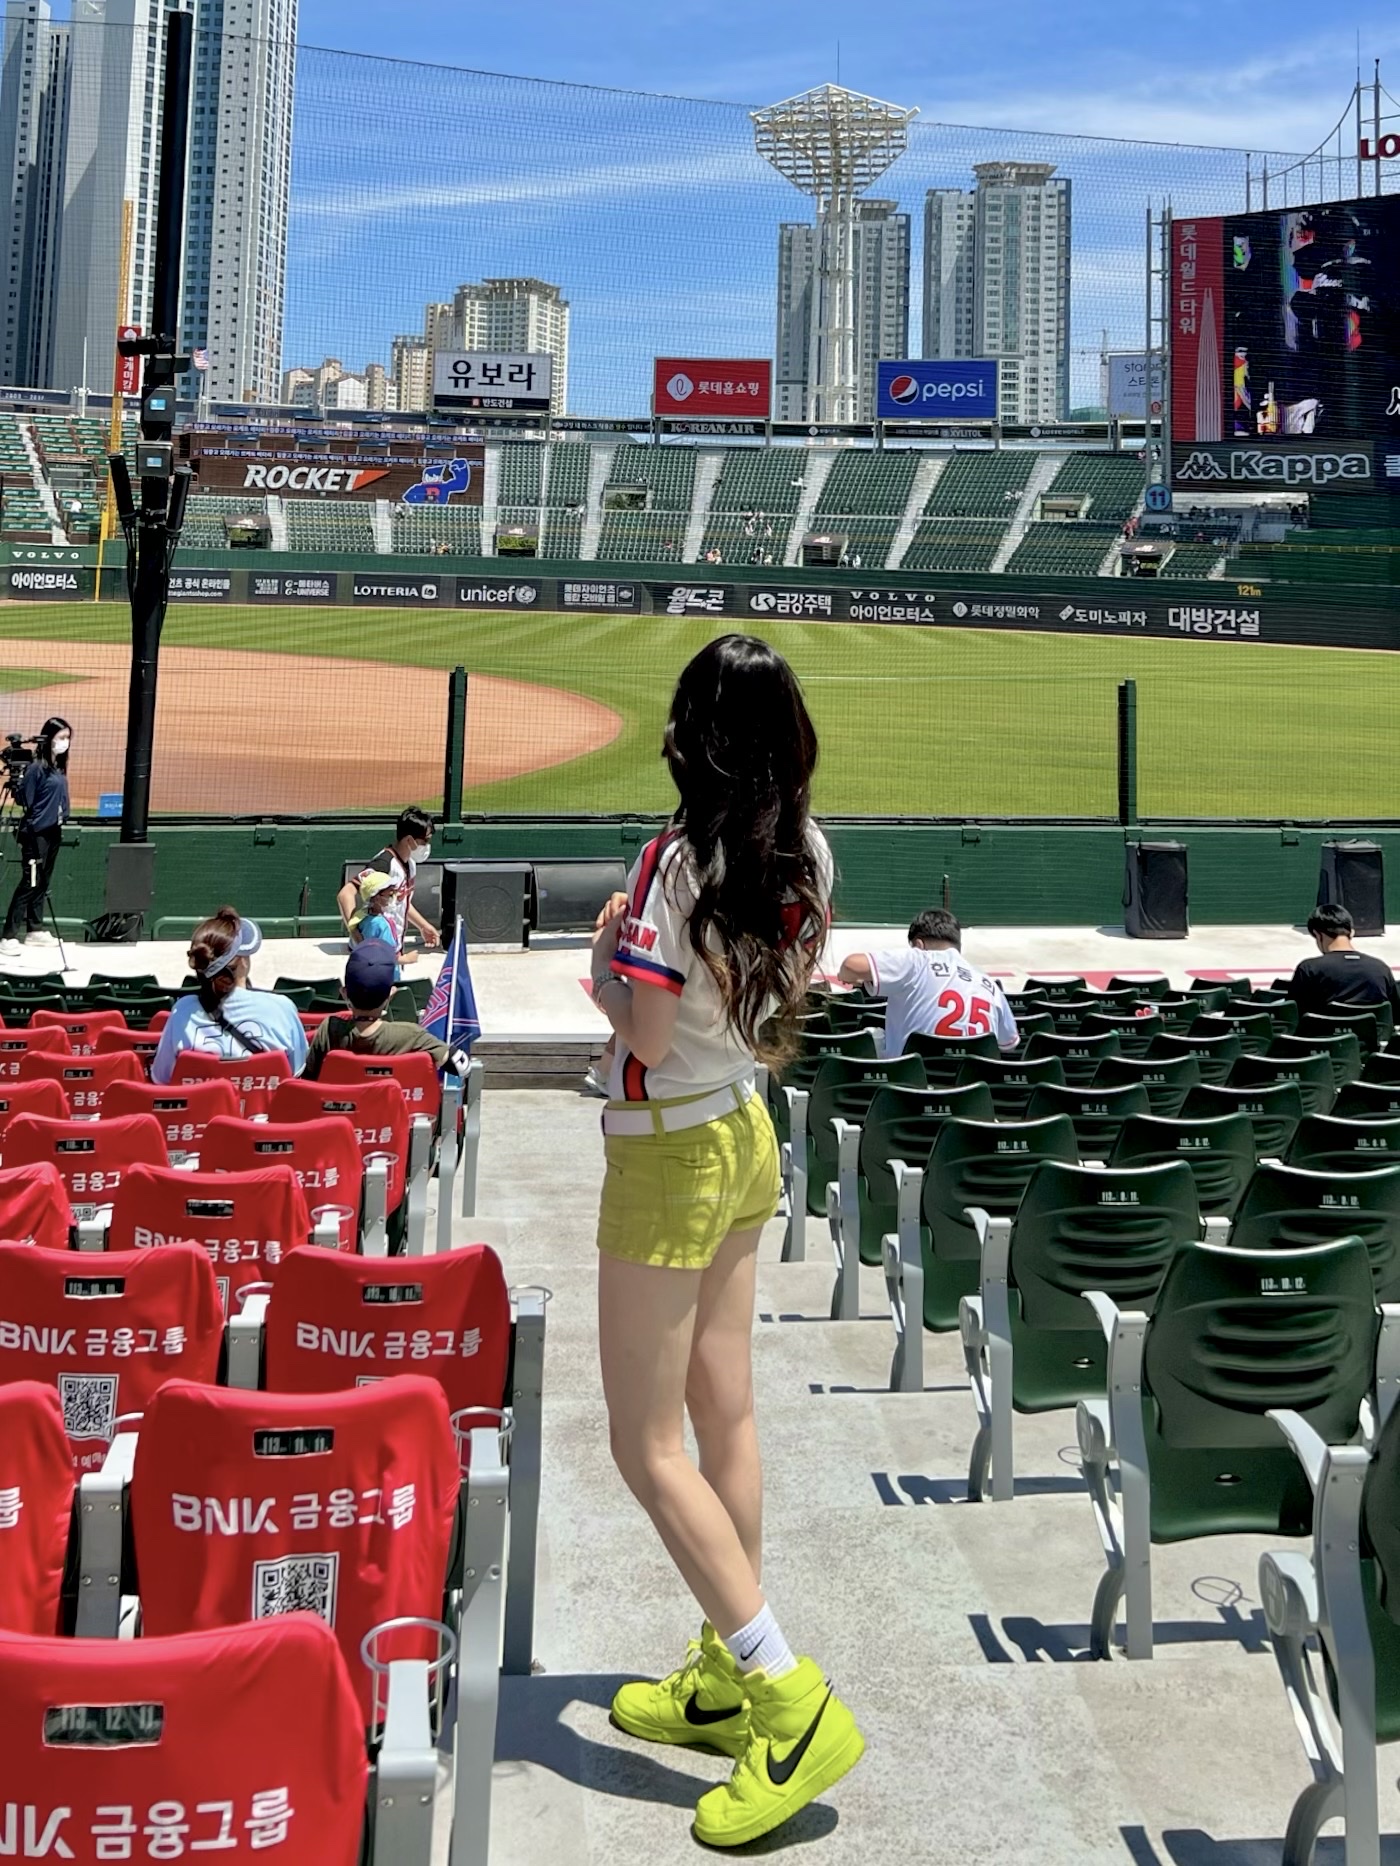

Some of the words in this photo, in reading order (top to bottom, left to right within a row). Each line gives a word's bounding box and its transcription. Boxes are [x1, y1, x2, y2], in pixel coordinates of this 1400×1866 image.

[1179, 224, 1198, 335] 롯데월드타워
[448, 360, 537, 391] 유보라
[698, 380, 759, 396] 롯데홈쇼핑
[923, 379, 984, 401] pepsi
[670, 422, 728, 433] KOREAN
[728, 423, 755, 434] AIR
[950, 429, 983, 438] XYLITOL
[244, 465, 363, 491] ROCKET
[1231, 452, 1370, 484] Kappa
[1149, 491, 1166, 506] 11
[12, 551, 80, 559] VOLVO
[11, 572, 78, 590] 아이언모터스
[354, 585, 419, 597] LOTTERIA
[1237, 585, 1262, 596] 121m
[285, 588, 330, 597] G-UNIVERSE
[460, 586, 515, 602] unicef
[667, 587, 724, 614] 월드콘
[850, 591, 935, 602] VOLVO
[777, 592, 831, 615] 금강주택
[850, 605, 935, 622] 아이언모터스
[971, 604, 1040, 618] 롯데정밀화학
[1074, 609, 1147, 626] 도미노피자
[1168, 607, 1260, 636] 대방건설
[934, 989, 990, 1036] 25
[204, 1239, 283, 1264] 금융그룹
[0, 1320, 78, 1356] BNK
[85, 1326, 187, 1357] 금융그룹
[297, 1322, 376, 1358] BNK
[383, 1327, 483, 1359] 금융그룹
[172, 1493, 280, 1536] BNK
[289, 1483, 417, 1530] 금융그룹
[91, 1786, 295, 1860] 금융그룹
